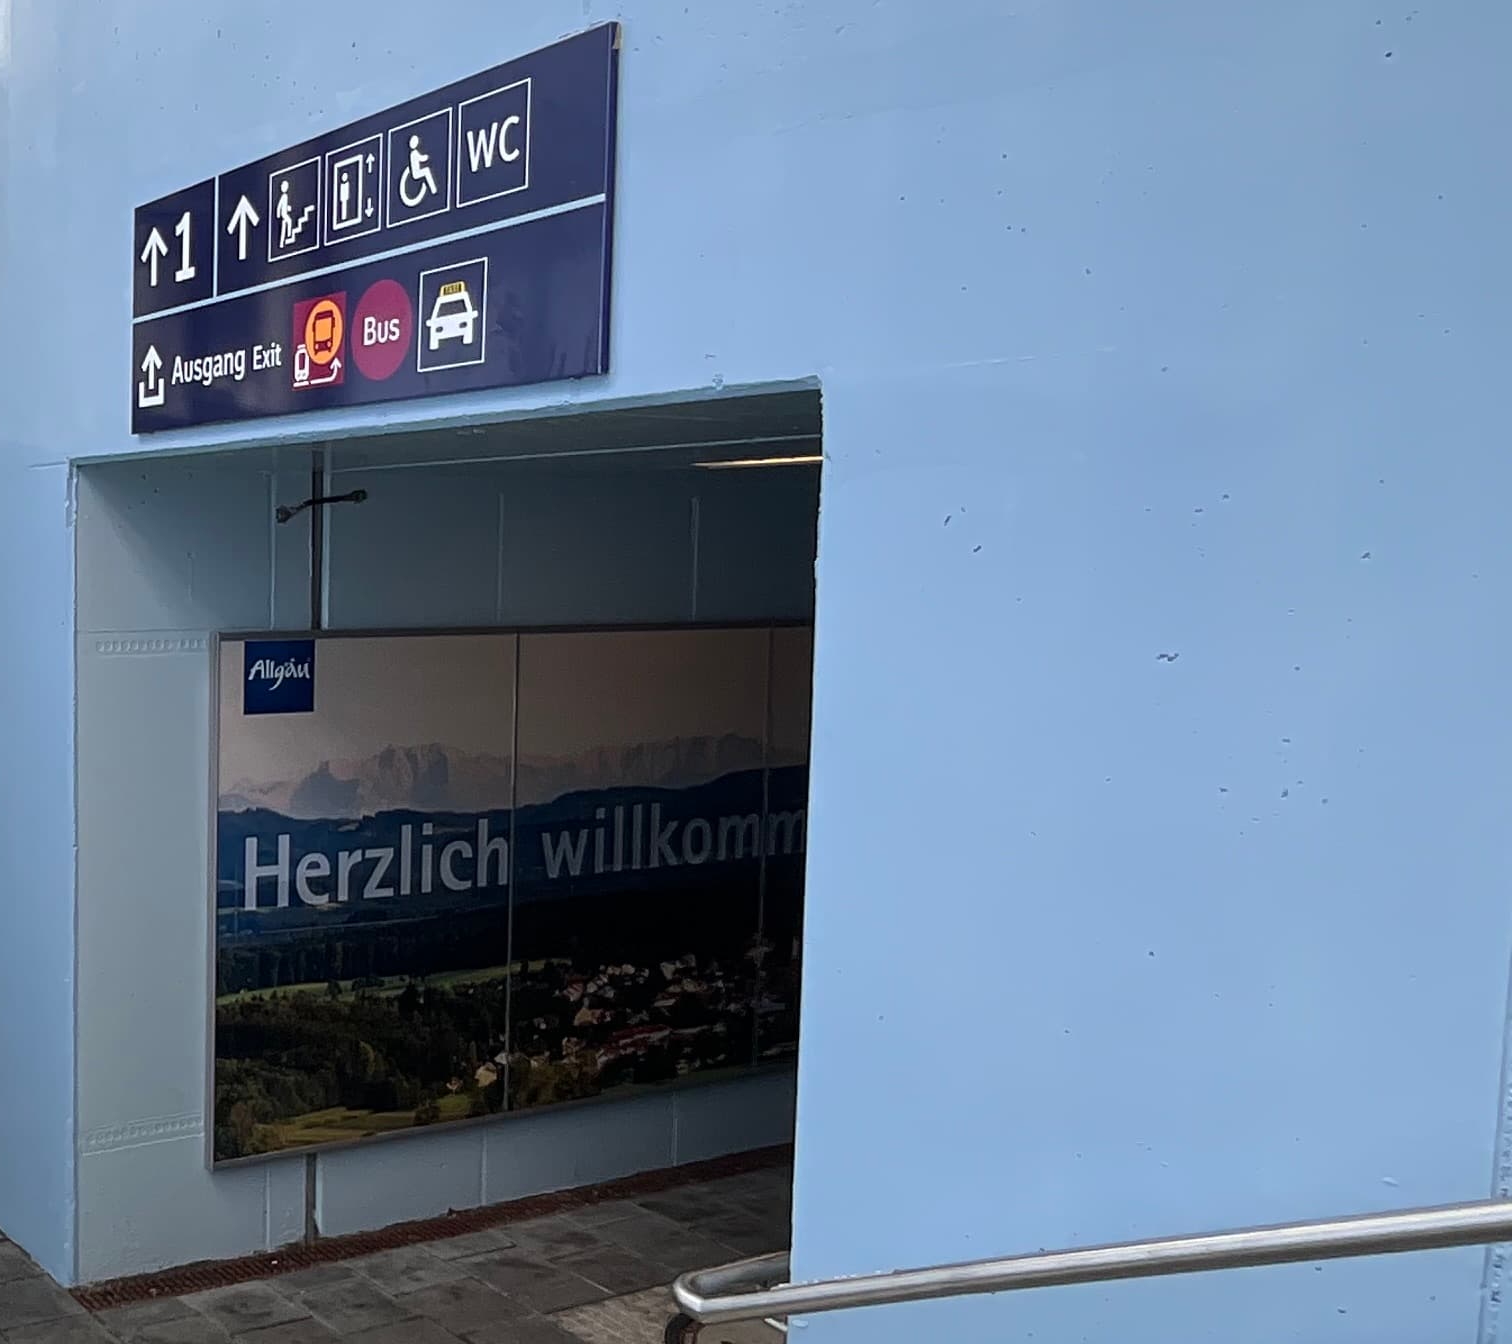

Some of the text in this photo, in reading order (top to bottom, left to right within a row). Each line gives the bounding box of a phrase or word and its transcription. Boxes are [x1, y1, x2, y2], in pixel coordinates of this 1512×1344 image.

[467, 115, 520, 172] WC
[174, 210, 196, 282] 1
[363, 316, 400, 347] Bus
[171, 343, 282, 385] Ausgang Exit
[248, 657, 310, 691] Allgäu
[244, 803, 805, 911] Herzlich willkomm
